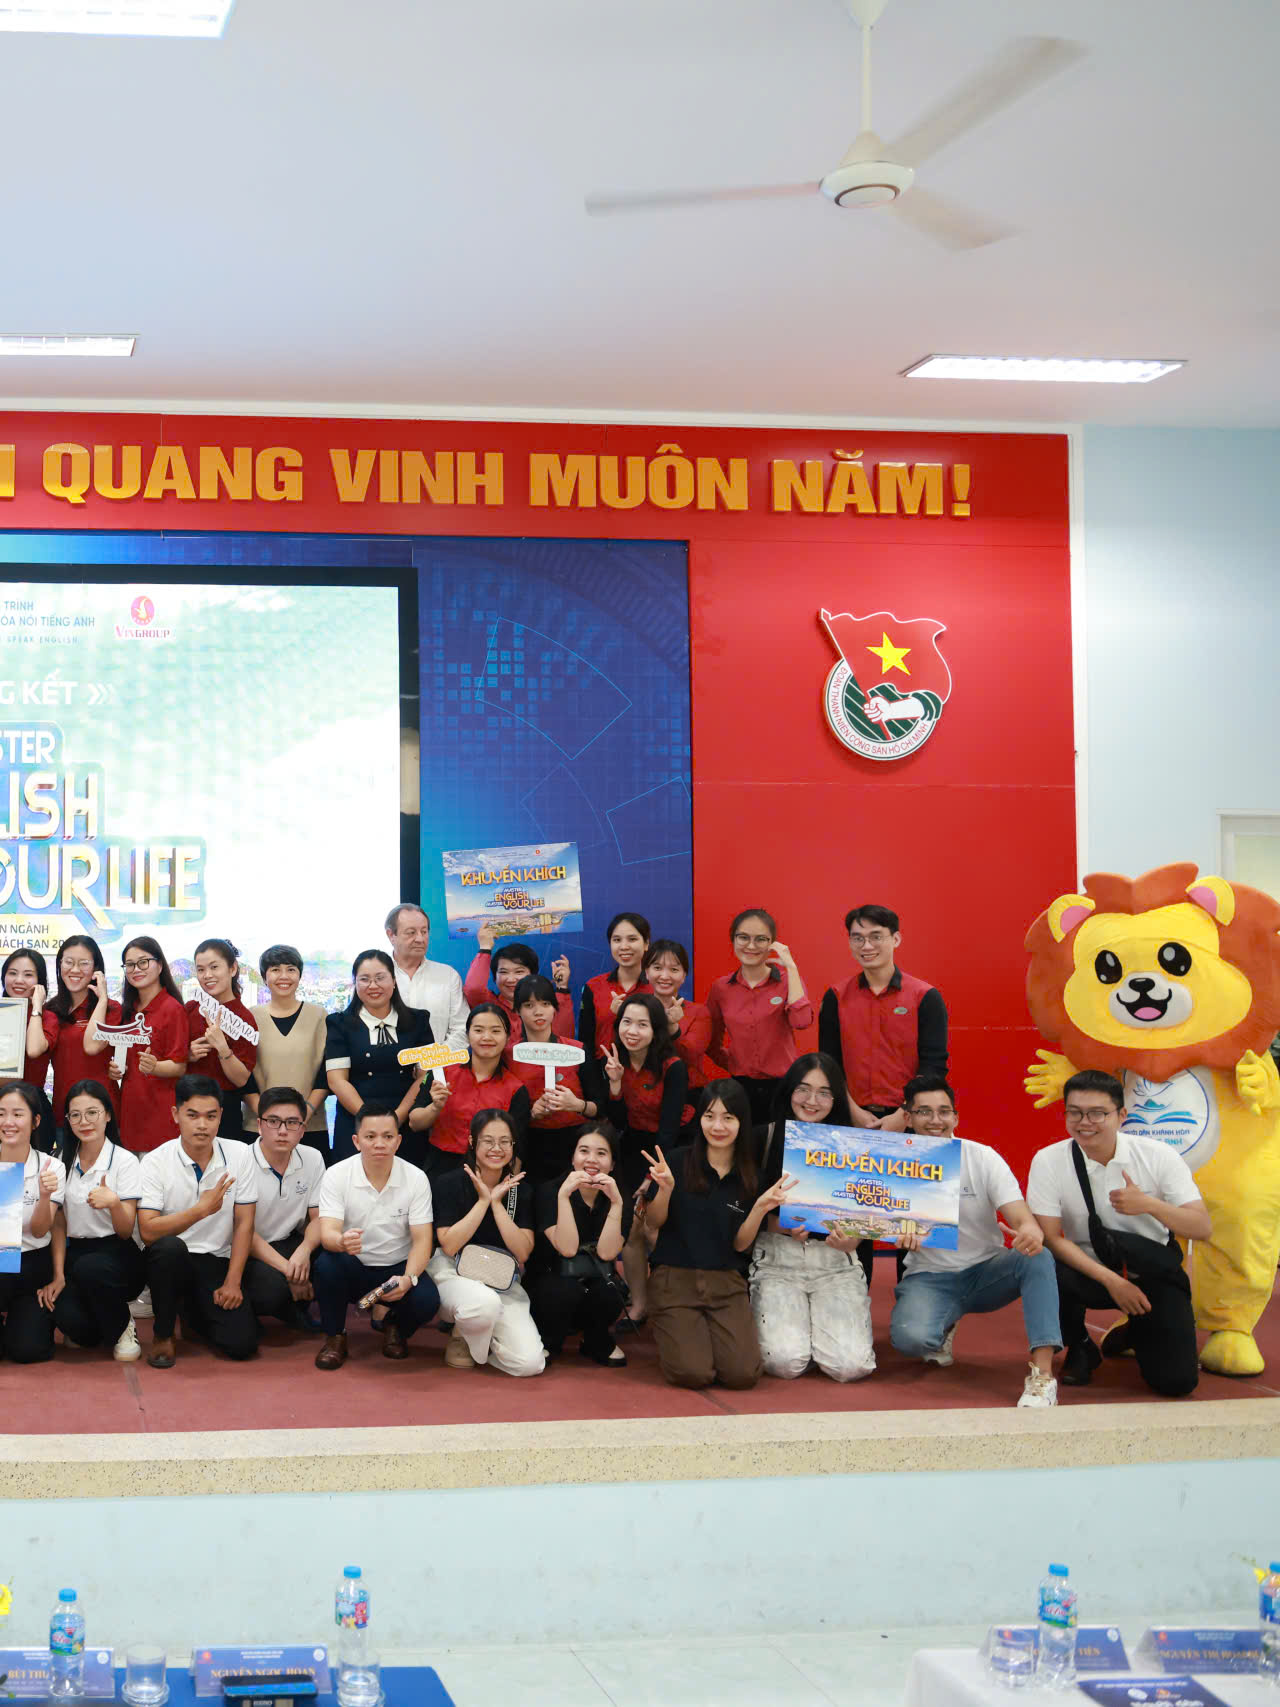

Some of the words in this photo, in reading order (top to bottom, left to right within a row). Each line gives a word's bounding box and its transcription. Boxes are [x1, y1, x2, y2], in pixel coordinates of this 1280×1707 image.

[41, 443, 303, 504] QUANG
[329, 447, 504, 505] VINH
[529, 443, 749, 511] MUÔN
[772, 448, 971, 517] NĂM!
[73, 616, 95, 627] ANH
[23, 668, 78, 705] KẾT
[830, 689, 841, 719] THANH
[911, 722, 929, 742] MINH
[106, 845, 202, 911] LIFE
[461, 864, 522, 887] KHUYẾN
[524, 864, 567, 882] KHÍCH
[495, 892, 529, 901] ENGLISH
[10, 921, 49, 934] NGÀNH
[805, 1148, 884, 1175] KHUYẾN
[887, 1158, 944, 1182] KHÍCH
[845, 1183, 891, 1197] ENGLISH
[855, 1193, 893, 1211] YOUR
[891, 1199, 910, 1210] LIFE
